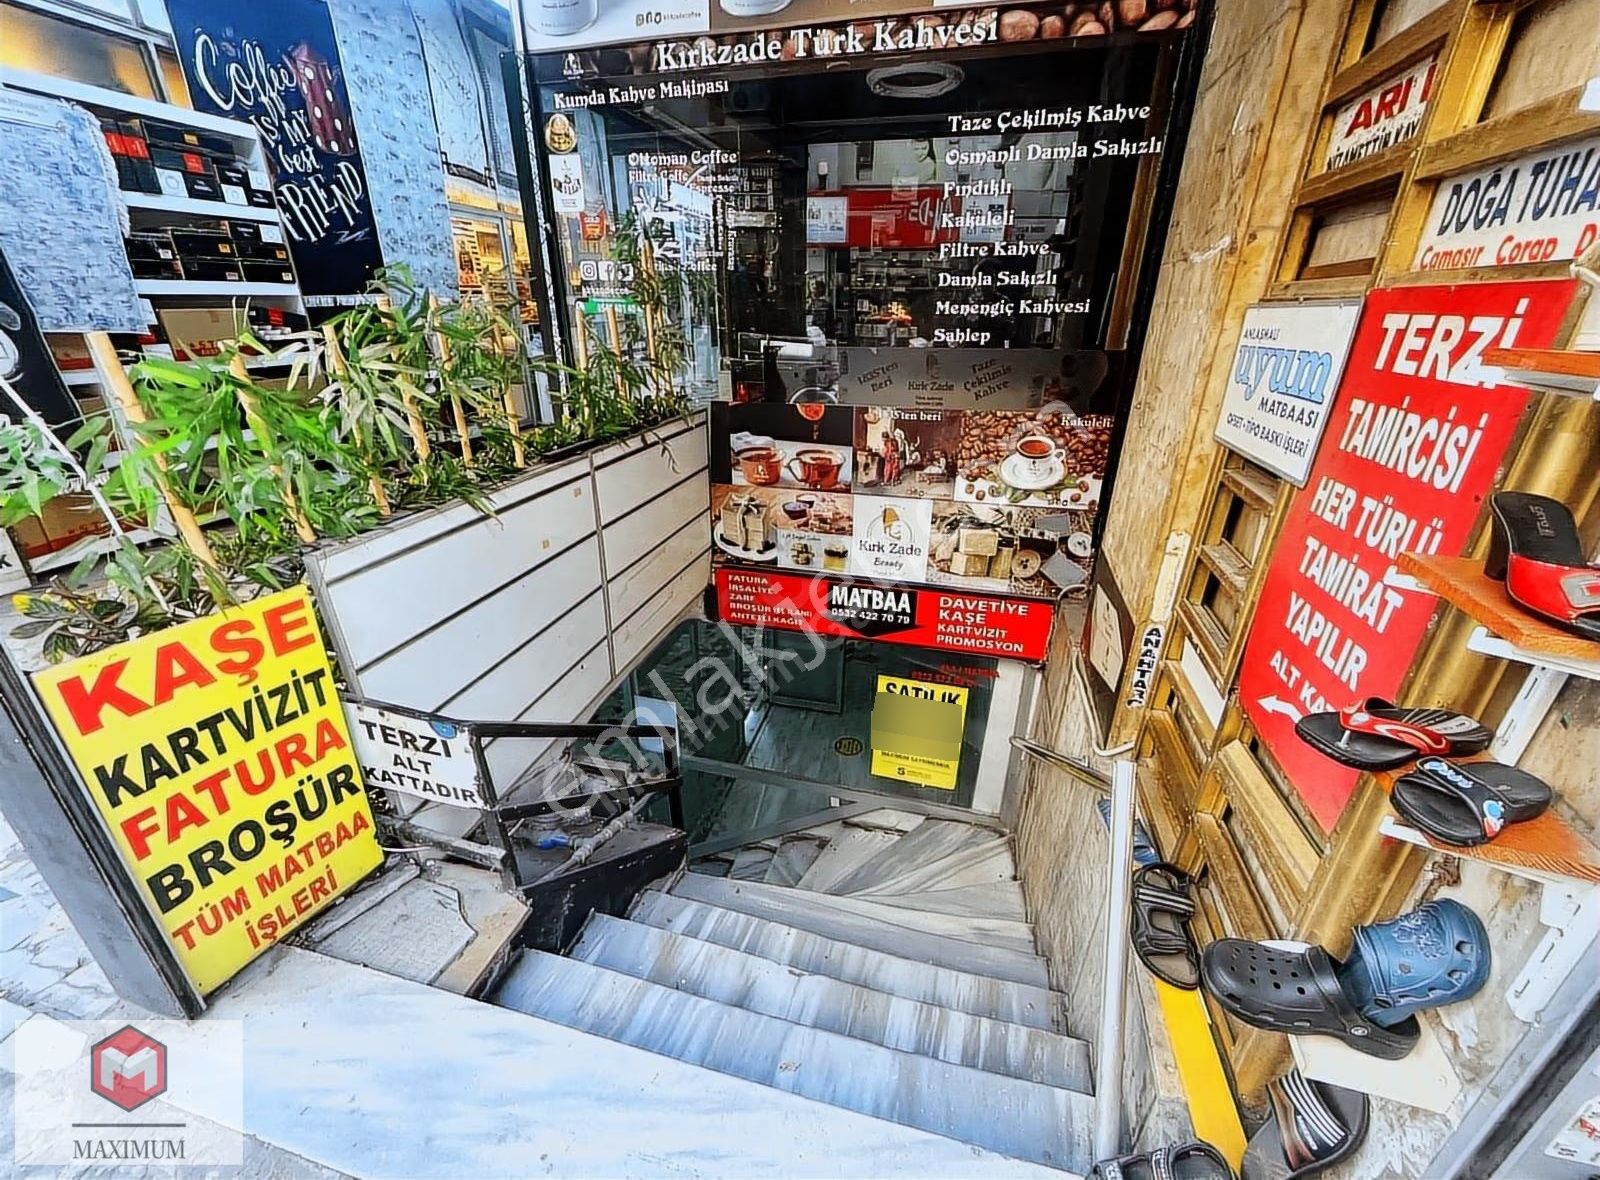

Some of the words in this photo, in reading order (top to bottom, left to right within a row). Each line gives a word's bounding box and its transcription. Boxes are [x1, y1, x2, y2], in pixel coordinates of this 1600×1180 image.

[656, 39, 784, 71] Kırkzade
[789, 25, 865, 57] Türk
[873, 12, 999, 50] Kahvesi
[194, 33, 297, 127] Coffee
[554, 91, 606, 109] Kumda
[609, 86, 656, 105] Kahve
[660, 79, 730, 97] Makinası
[948, 114, 992, 132] Taze
[997, 110, 1082, 133] Çekilmiş
[1087, 103, 1151, 124] Kahve
[1344, 75, 1414, 139] ARI
[249, 113, 280, 149] IS
[282, 110, 313, 147] MY
[278, 144, 322, 173] best
[628, 151, 688, 168] Ottoman
[691, 150, 737, 165] Coffee
[946, 147, 1021, 167] Osmanlı
[1027, 142, 1088, 161] Damla
[1093, 137, 1163, 158] Sakızlı
[276, 161, 362, 243] FRIEND
[943, 180, 1012, 199] Fındıklı
[1437, 168, 1520, 236] DOĞA
[939, 242, 990, 260] Filtre
[993, 240, 1050, 257] Kahve
[938, 272, 992, 288] Damla
[997, 270, 1057, 288] Sakızlı
[936, 301, 1014, 318] Menengiç
[1019, 299, 1090, 315] Kahvesi
[934, 328, 991, 345] Sahlep
[1373, 298, 1530, 386] TERZİ
[1235, 345, 1333, 404] uyum
[1258, 396, 1320, 429] MATBAASI
[1339, 396, 1489, 494] TAMİRCİSİ
[1310, 475, 1357, 532] HER
[888, 543, 922, 557] Zade
[728, 574, 769, 585] FATURA
[1299, 535, 1404, 634] TAMİRAT
[831, 585, 911, 613] MATBAA
[938, 609, 987, 625] KAŞE
[939, 596, 1029, 616] DAVETİYE
[936, 635, 1024, 653] PROMOSYON
[937, 623, 1008, 639] KARTVİZİT
[1285, 591, 1368, 693] YAPILIR
[57, 598, 316, 737] KAŞE
[1270, 650, 1301, 689] ALT
[93, 668, 328, 808] KARTVİZİT
[393, 754, 431, 774] ALT
[120, 717, 347, 861] FATURA
[362, 765, 477, 803] KATTADIR
[146, 763, 361, 914] BROŞÜR
[171, 885, 252, 951] TÜM
[255, 810, 370, 896] MATBAA
[245, 863, 338, 948] İŞLERİ
